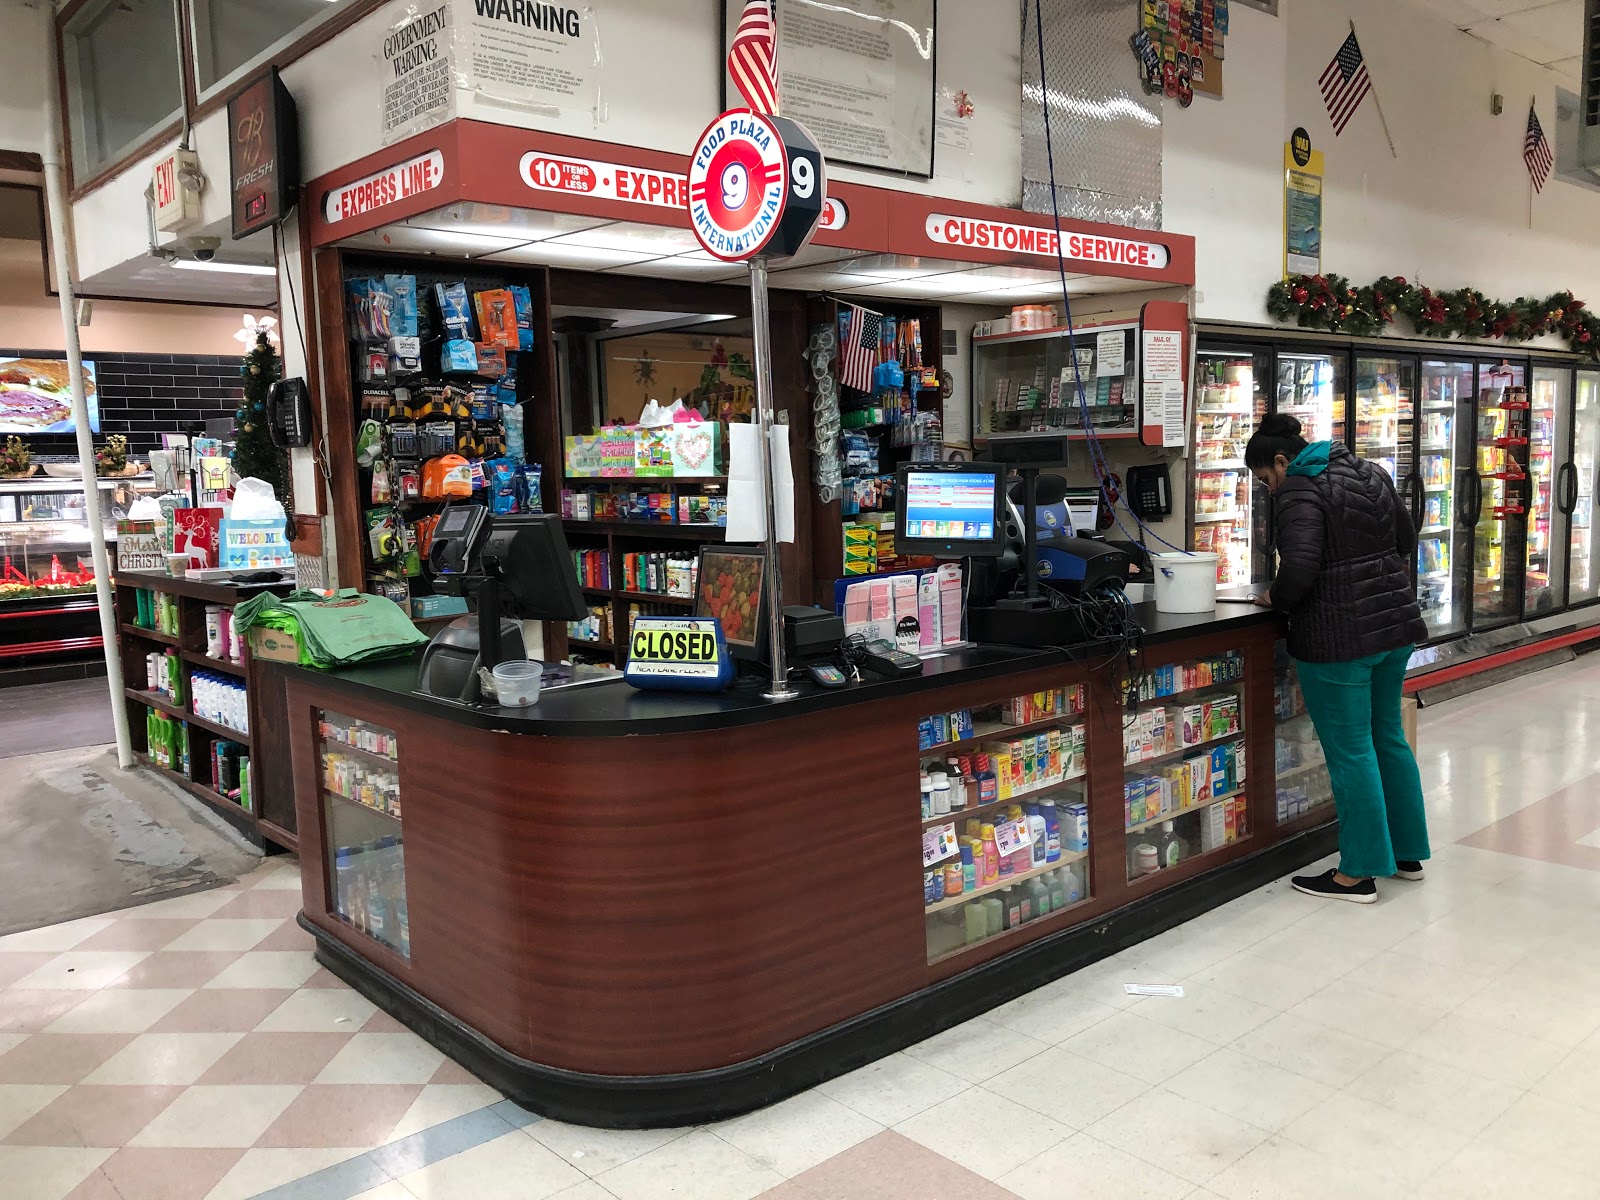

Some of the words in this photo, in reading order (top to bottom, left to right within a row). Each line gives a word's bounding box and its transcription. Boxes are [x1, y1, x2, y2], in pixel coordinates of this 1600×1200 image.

[383, 5, 446, 60] GOVERNMENT
[474, 0, 580, 38] WARNING
[697, 127, 725, 170] FOOD
[730, 120, 771, 151] PLAZA
[156, 156, 175, 208] EXIT
[235, 159, 274, 191] FRESH
[340, 173, 397, 219] EXPRESS
[401, 159, 433, 196] LINE
[535, 160, 560, 187] 10
[615, 169, 688, 207] EXPRE
[562, 164, 589, 176] ITEMS
[564, 180, 588, 191] LESS
[721, 161, 748, 210] 9
[792, 156, 815, 198] 9
[693, 186, 781, 252] INTERNATIONAL
[944, 219, 1061, 255] CUSTOMER
[1069, 236, 1149, 266] SERVICE
[228, 532, 281, 545] WELCOME
[248, 549, 294, 568] Baby
[119, 553, 167, 569] CHRISTM
[633, 631, 714, 660] CLOSED
